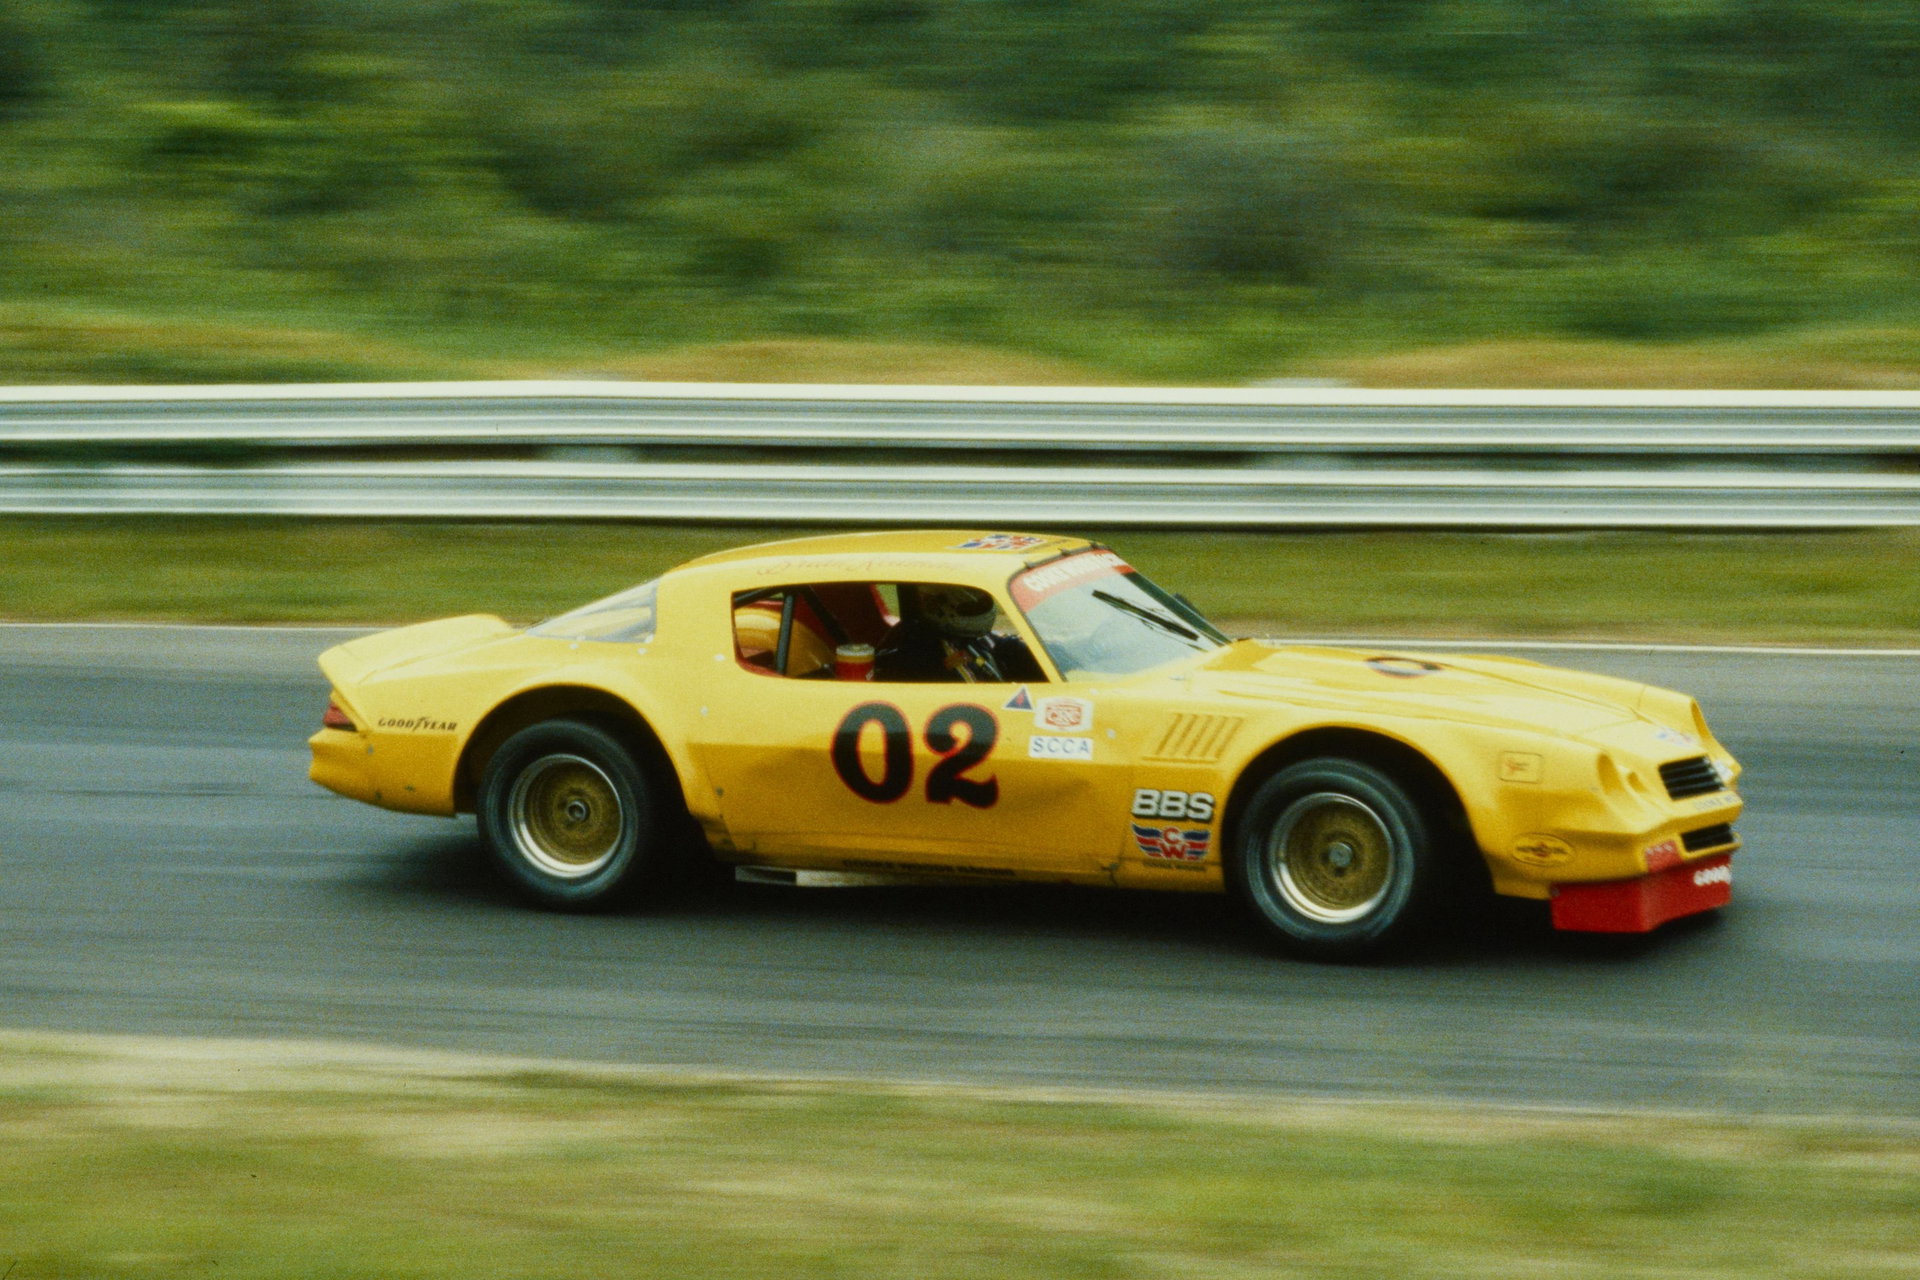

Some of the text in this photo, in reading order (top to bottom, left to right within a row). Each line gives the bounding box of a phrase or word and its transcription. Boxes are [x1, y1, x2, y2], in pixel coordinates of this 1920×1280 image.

[378, 716, 458, 732] GOODYEAR
[831, 700, 1000, 809] 02
[1032, 737, 1090, 754] SCCA
[1131, 787, 1215, 822] BBS
